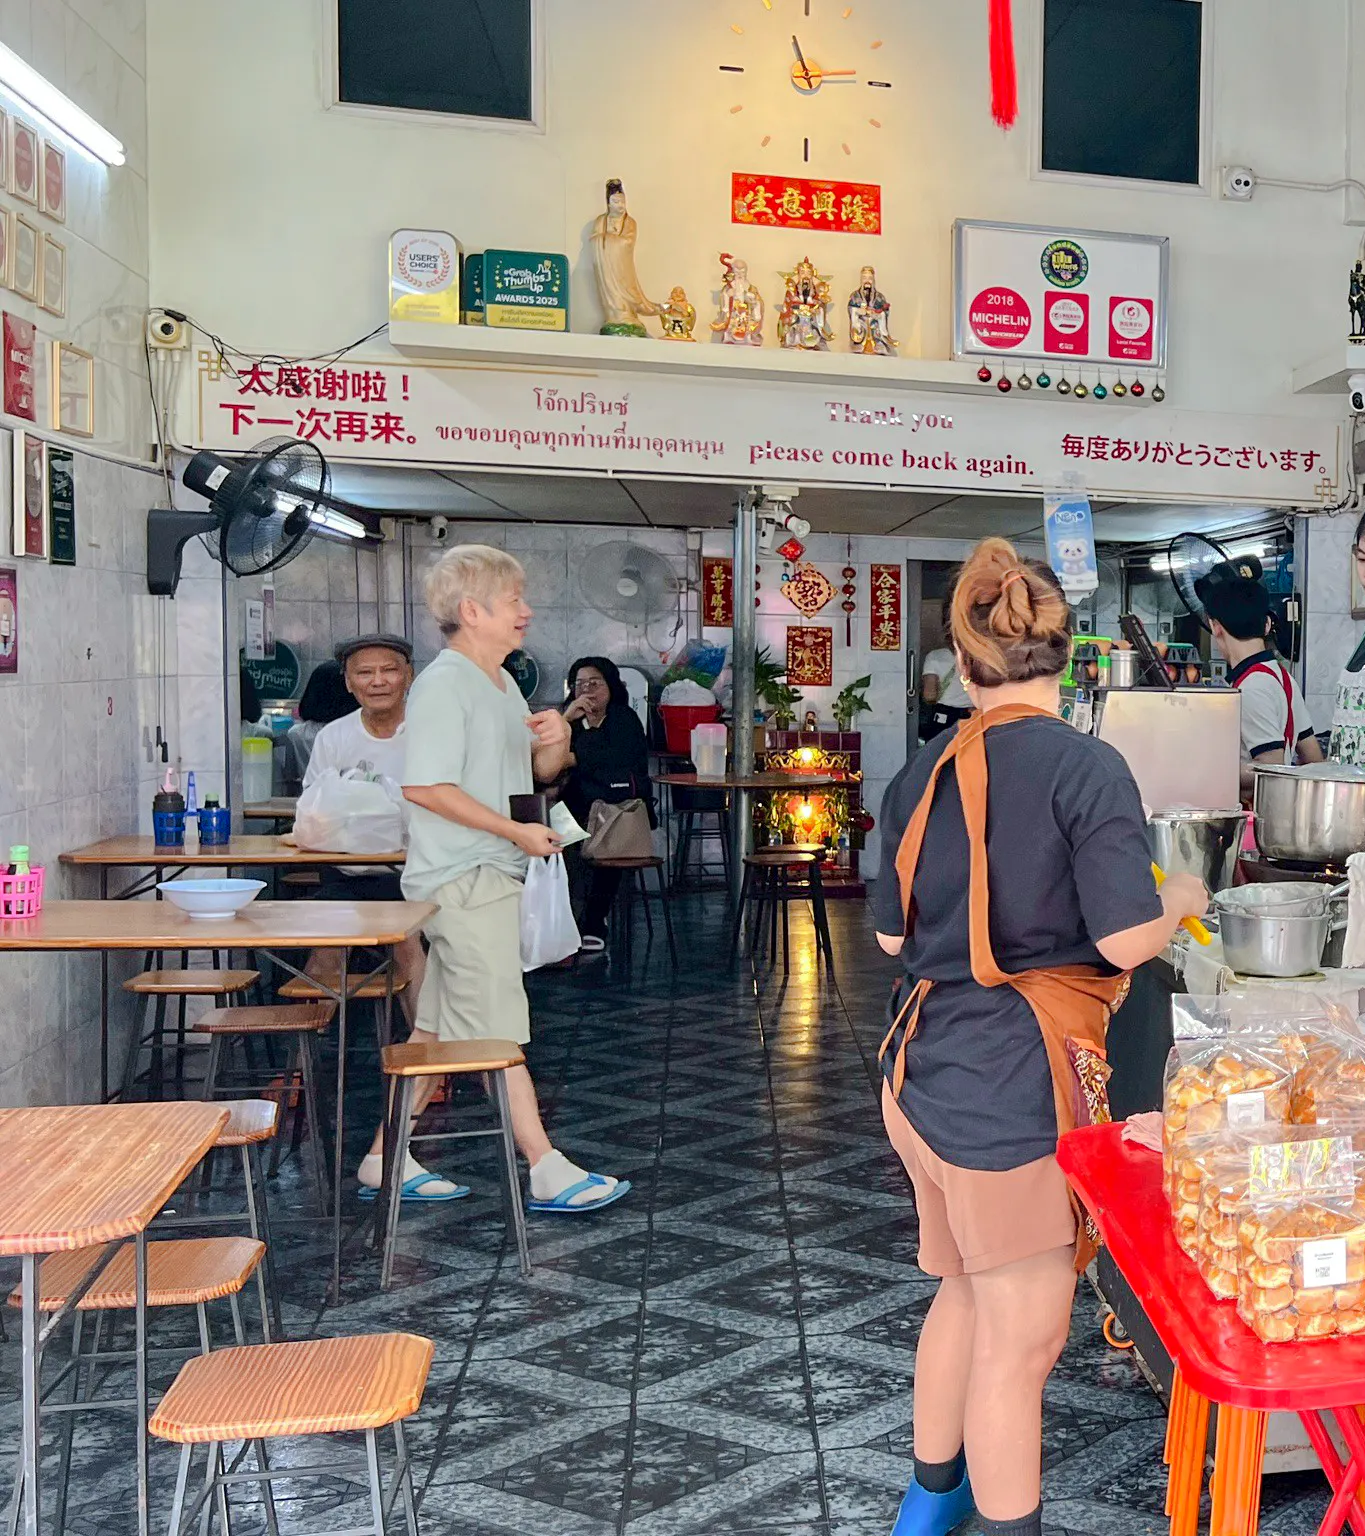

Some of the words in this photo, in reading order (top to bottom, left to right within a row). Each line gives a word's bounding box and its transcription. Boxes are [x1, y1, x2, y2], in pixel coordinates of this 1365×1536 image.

[744, 185, 869, 224] 生意興隆
[409, 261, 438, 269] CHOICE
[504, 272, 545, 287] Thumbs
[495, 293, 535, 304] AWARDS
[536, 296, 558, 306] 2025
[529, 282, 543, 293] Up
[987, 294, 1014, 306] 2018
[972, 312, 1030, 327] MICHELIN
[532, 386, 631, 416] โจ๊กปรินซ์
[219, 402, 417, 445] 下一次再来。
[825, 401, 904, 427] Thank
[911, 411, 954, 433] you
[435, 420, 725, 460] ขอขอบคุณทุกท่านที่มาอุดหนุน
[1061, 433, 1327, 475] 毎度ありがとうございます。
[749, 440, 824, 464] please
[831, 449, 894, 468] come
[902, 448, 958, 471] back
[966, 453, 1035, 479] again.
[875, 572, 898, 636] 合家平安
